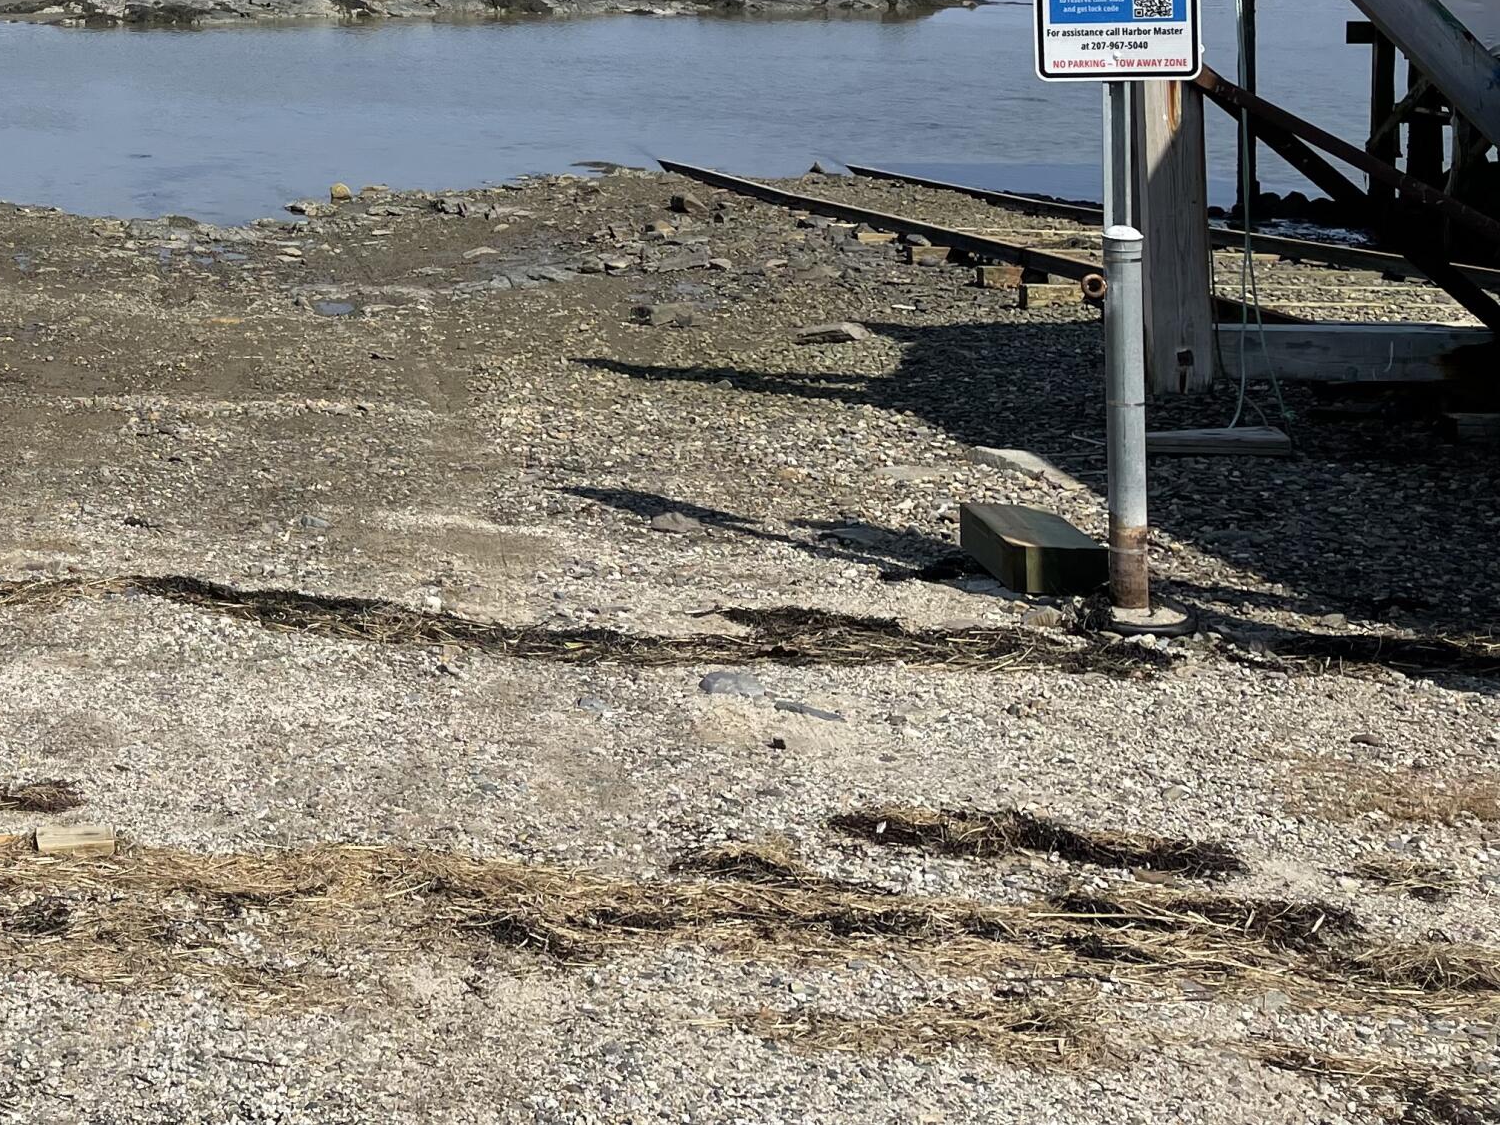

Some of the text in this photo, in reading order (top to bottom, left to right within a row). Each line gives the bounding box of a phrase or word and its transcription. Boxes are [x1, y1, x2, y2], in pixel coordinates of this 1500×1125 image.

[1047, 27, 1184, 37] For assistance call Harbor Master
[1091, 41, 1148, 49] 207-967-5040
[1053, 60, 1066, 68] NO
[1068, 59, 1106, 67] PARKING
[1114, 59, 1135, 67] TOW
[1136, 59, 1163, 67] AWAY
[1165, 58, 1188, 67] ZONE
